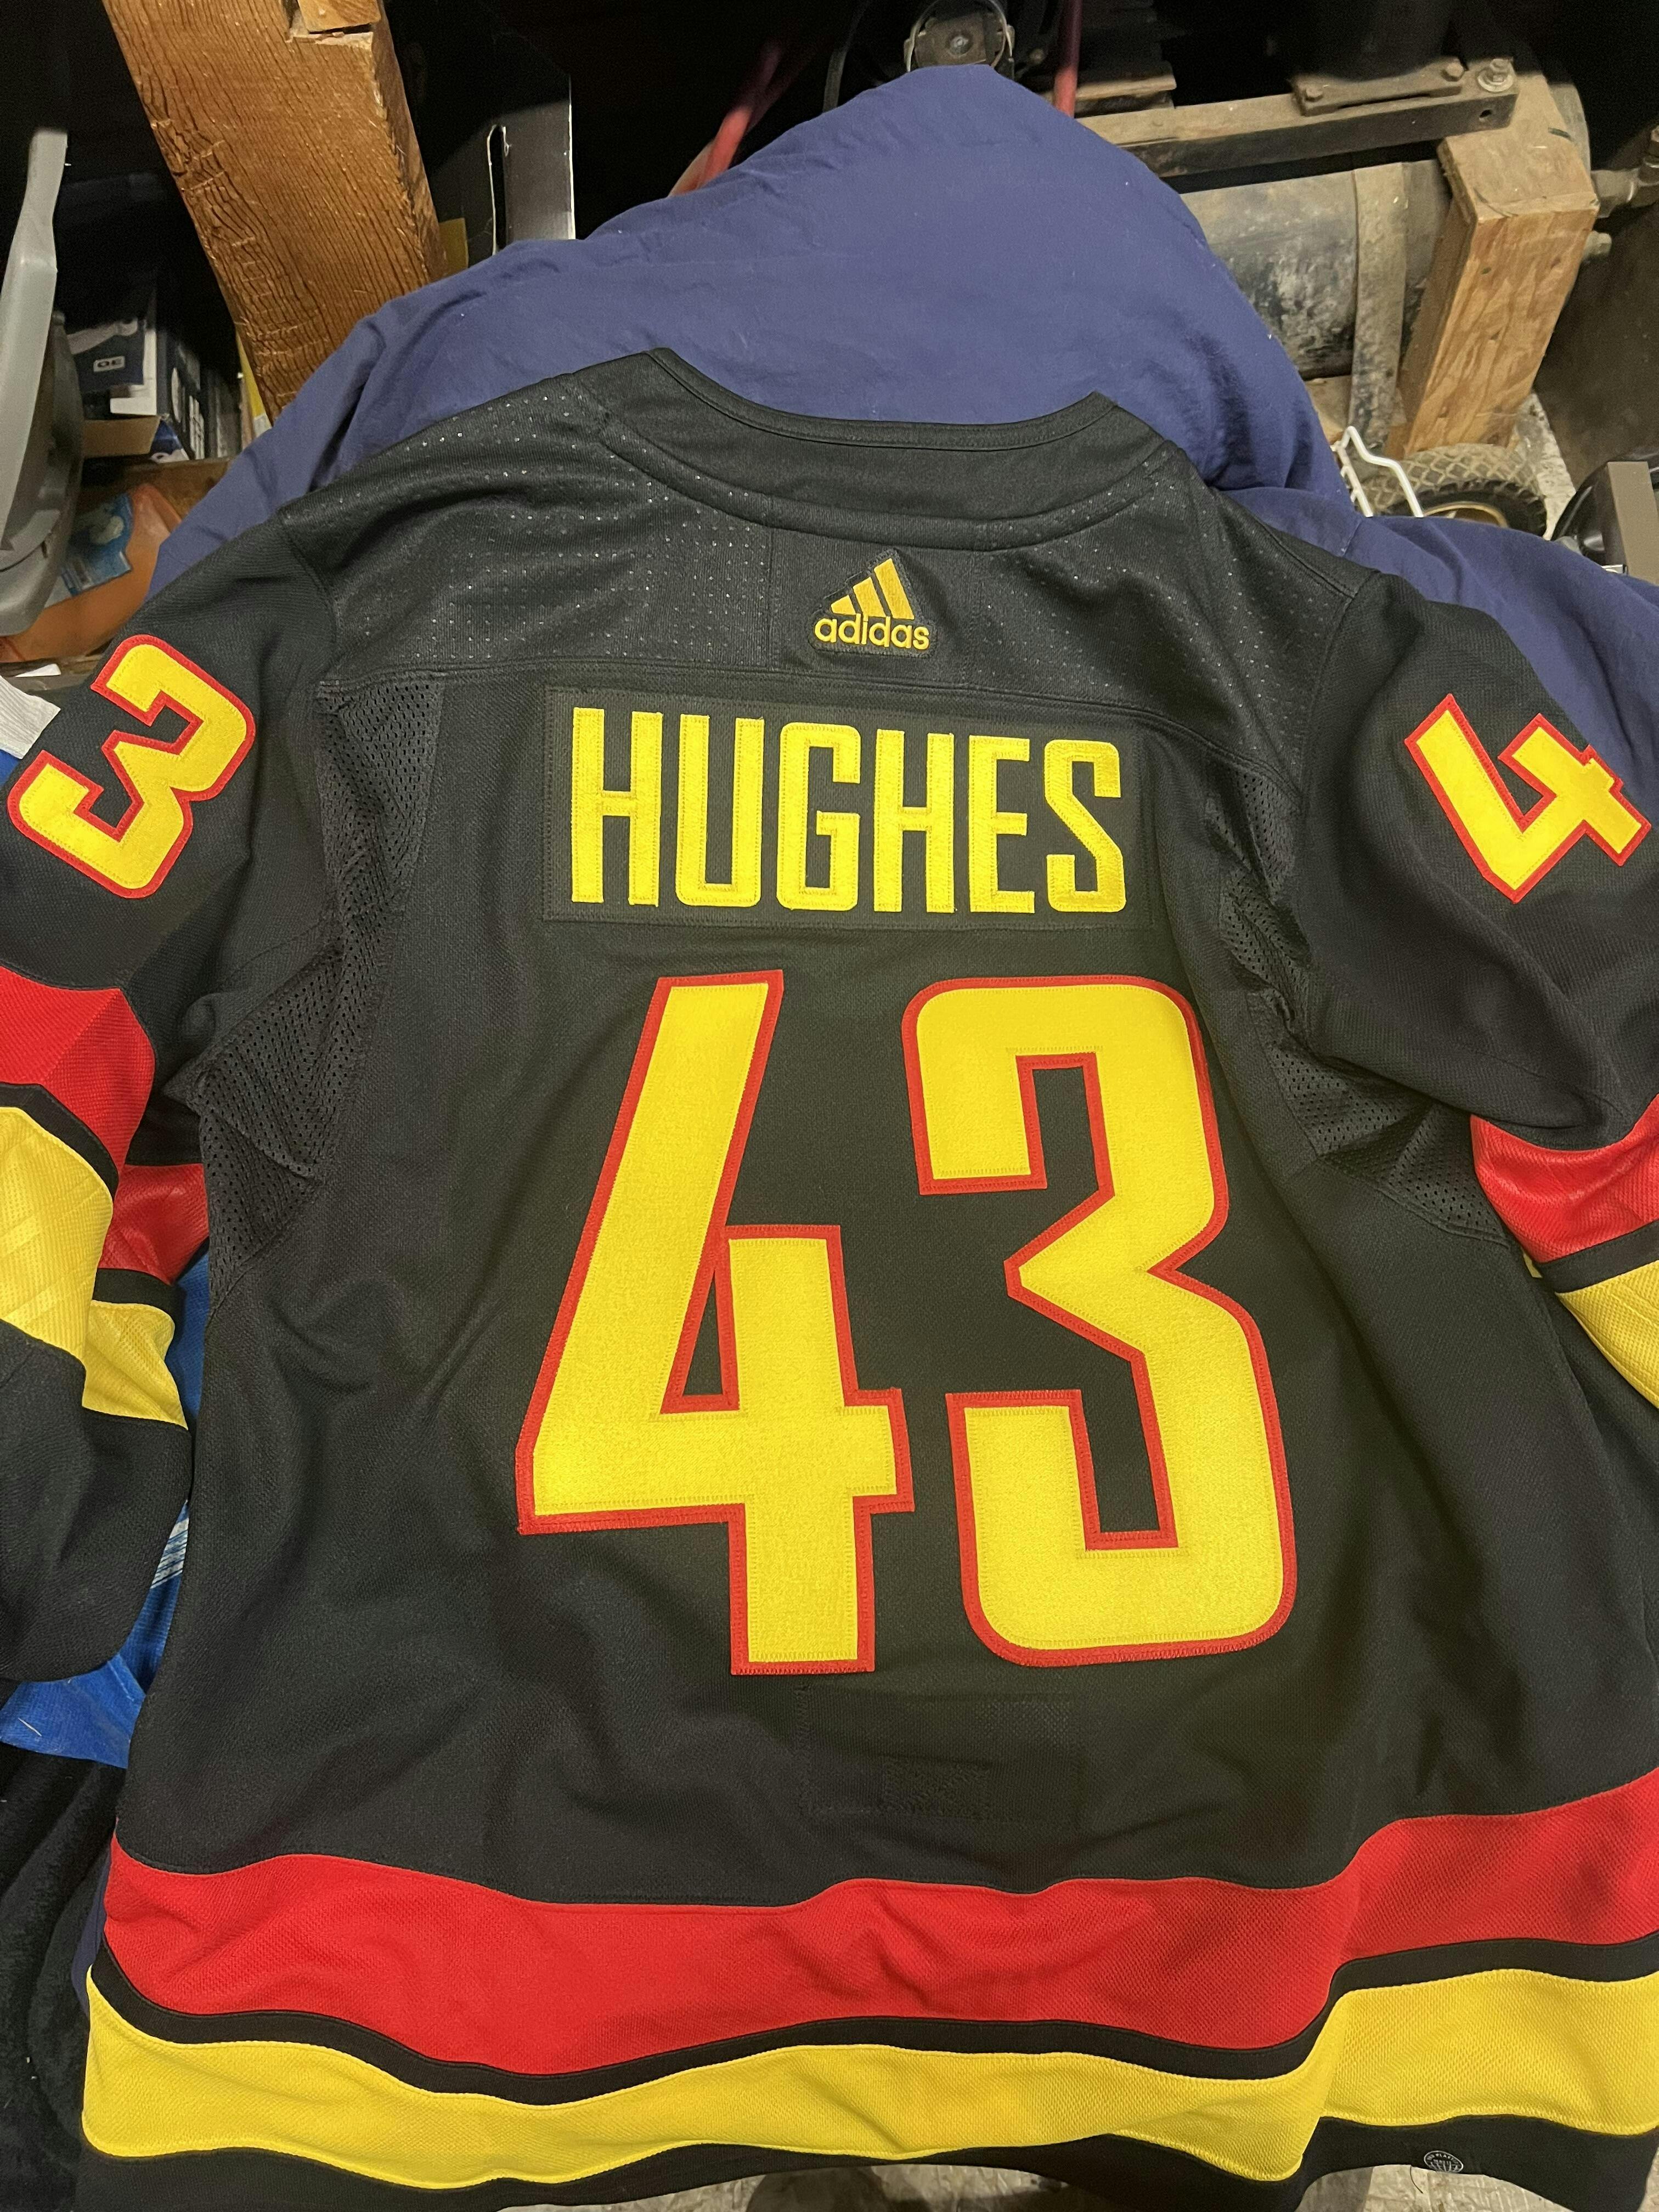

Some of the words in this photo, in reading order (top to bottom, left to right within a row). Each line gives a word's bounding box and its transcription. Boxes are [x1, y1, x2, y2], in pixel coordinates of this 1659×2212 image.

[814, 613, 930, 650] adidas
[7, 634, 256, 899] 3
[571, 707, 1127, 914] HUGHES
[1403, 693, 1652, 905] 4
[515, 969, 1298, 1676] 43
